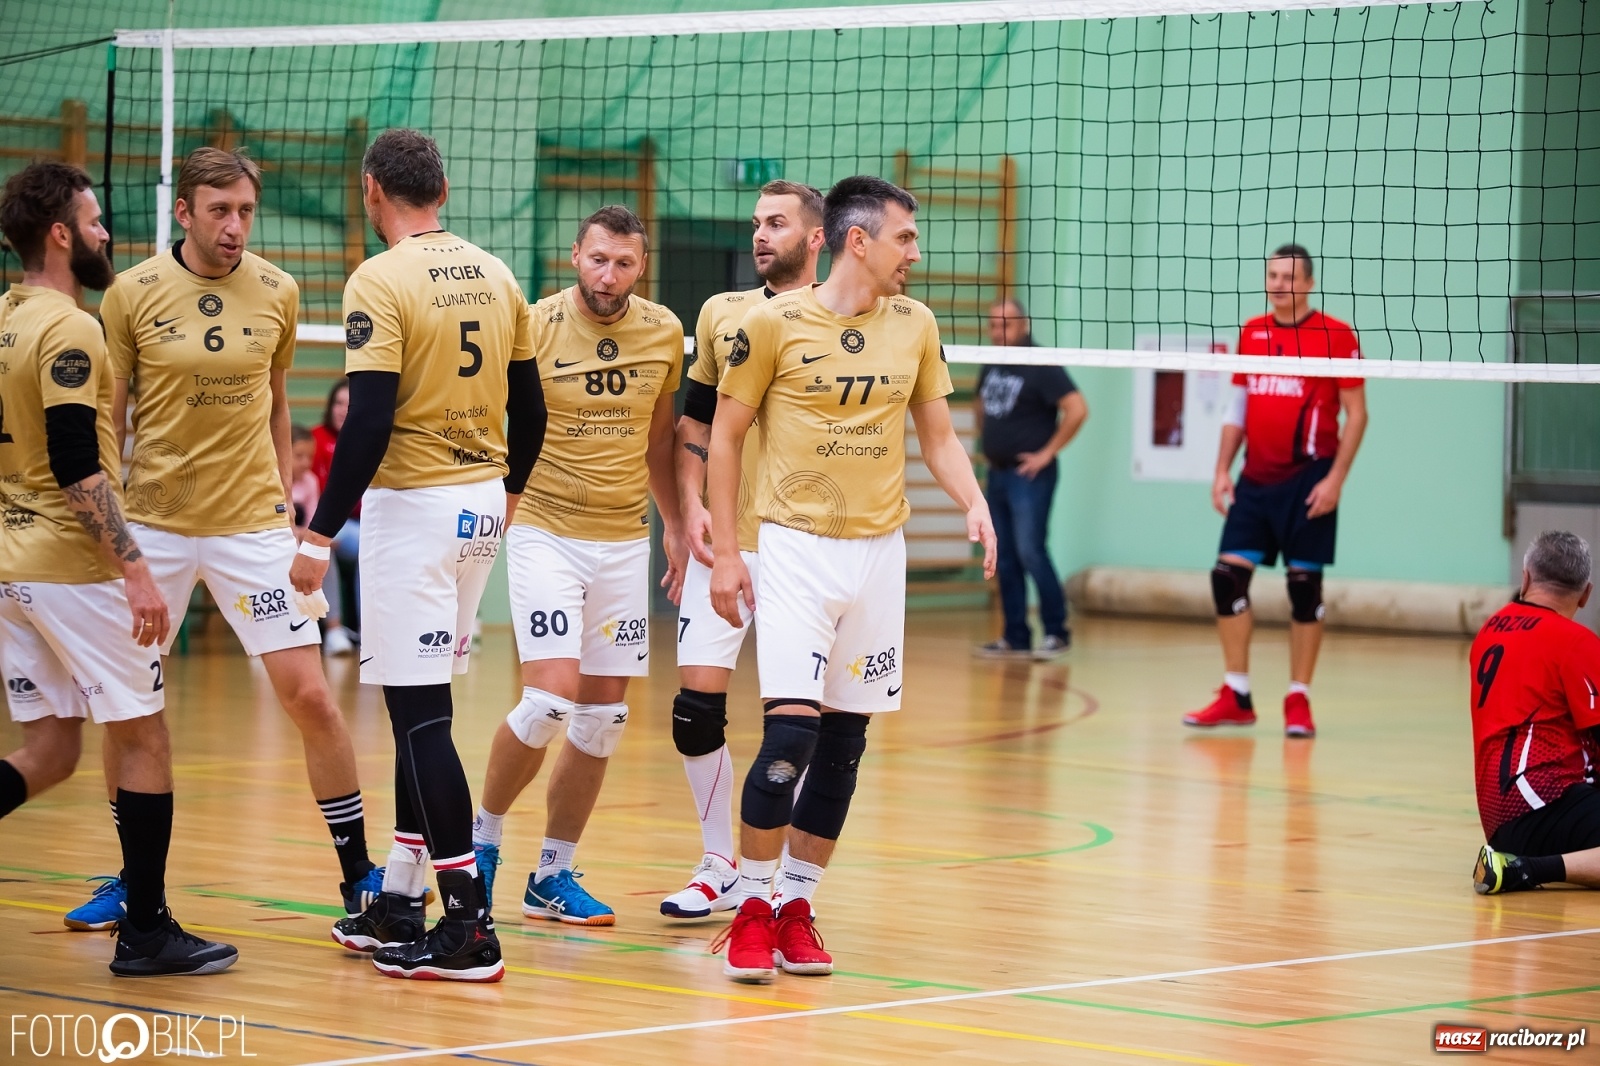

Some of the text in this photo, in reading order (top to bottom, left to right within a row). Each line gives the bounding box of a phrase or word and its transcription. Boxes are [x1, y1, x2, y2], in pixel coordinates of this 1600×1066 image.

[428, 265, 485, 282] PYCIEK
[204, 326, 225, 352] 6
[457, 320, 483, 378] 5
[194, 374, 250, 386] Towalski
[585, 370, 627, 396] 80
[186, 391, 254, 408] eXchange
[836, 376, 876, 406] 77
[445, 404, 489, 421] Towalski
[576, 407, 631, 419] Towalski
[566, 422, 636, 438] eXchange
[826, 423, 883, 436] Towalski
[816, 440, 888, 459] eXchange
[478, 514, 505, 539] DK
[456, 535, 500, 563] glass
[249, 589, 286, 607] ZOO
[253, 600, 289, 618] MAR
[530, 609, 569, 638] 80
[618, 617, 647, 631] ZOO
[615, 628, 646, 643] MAR
[865, 646, 896, 668] ZOO
[150, 660, 164, 692] 2
[863, 658, 896, 680] MAR
[1476, 643, 1505, 709] 9
